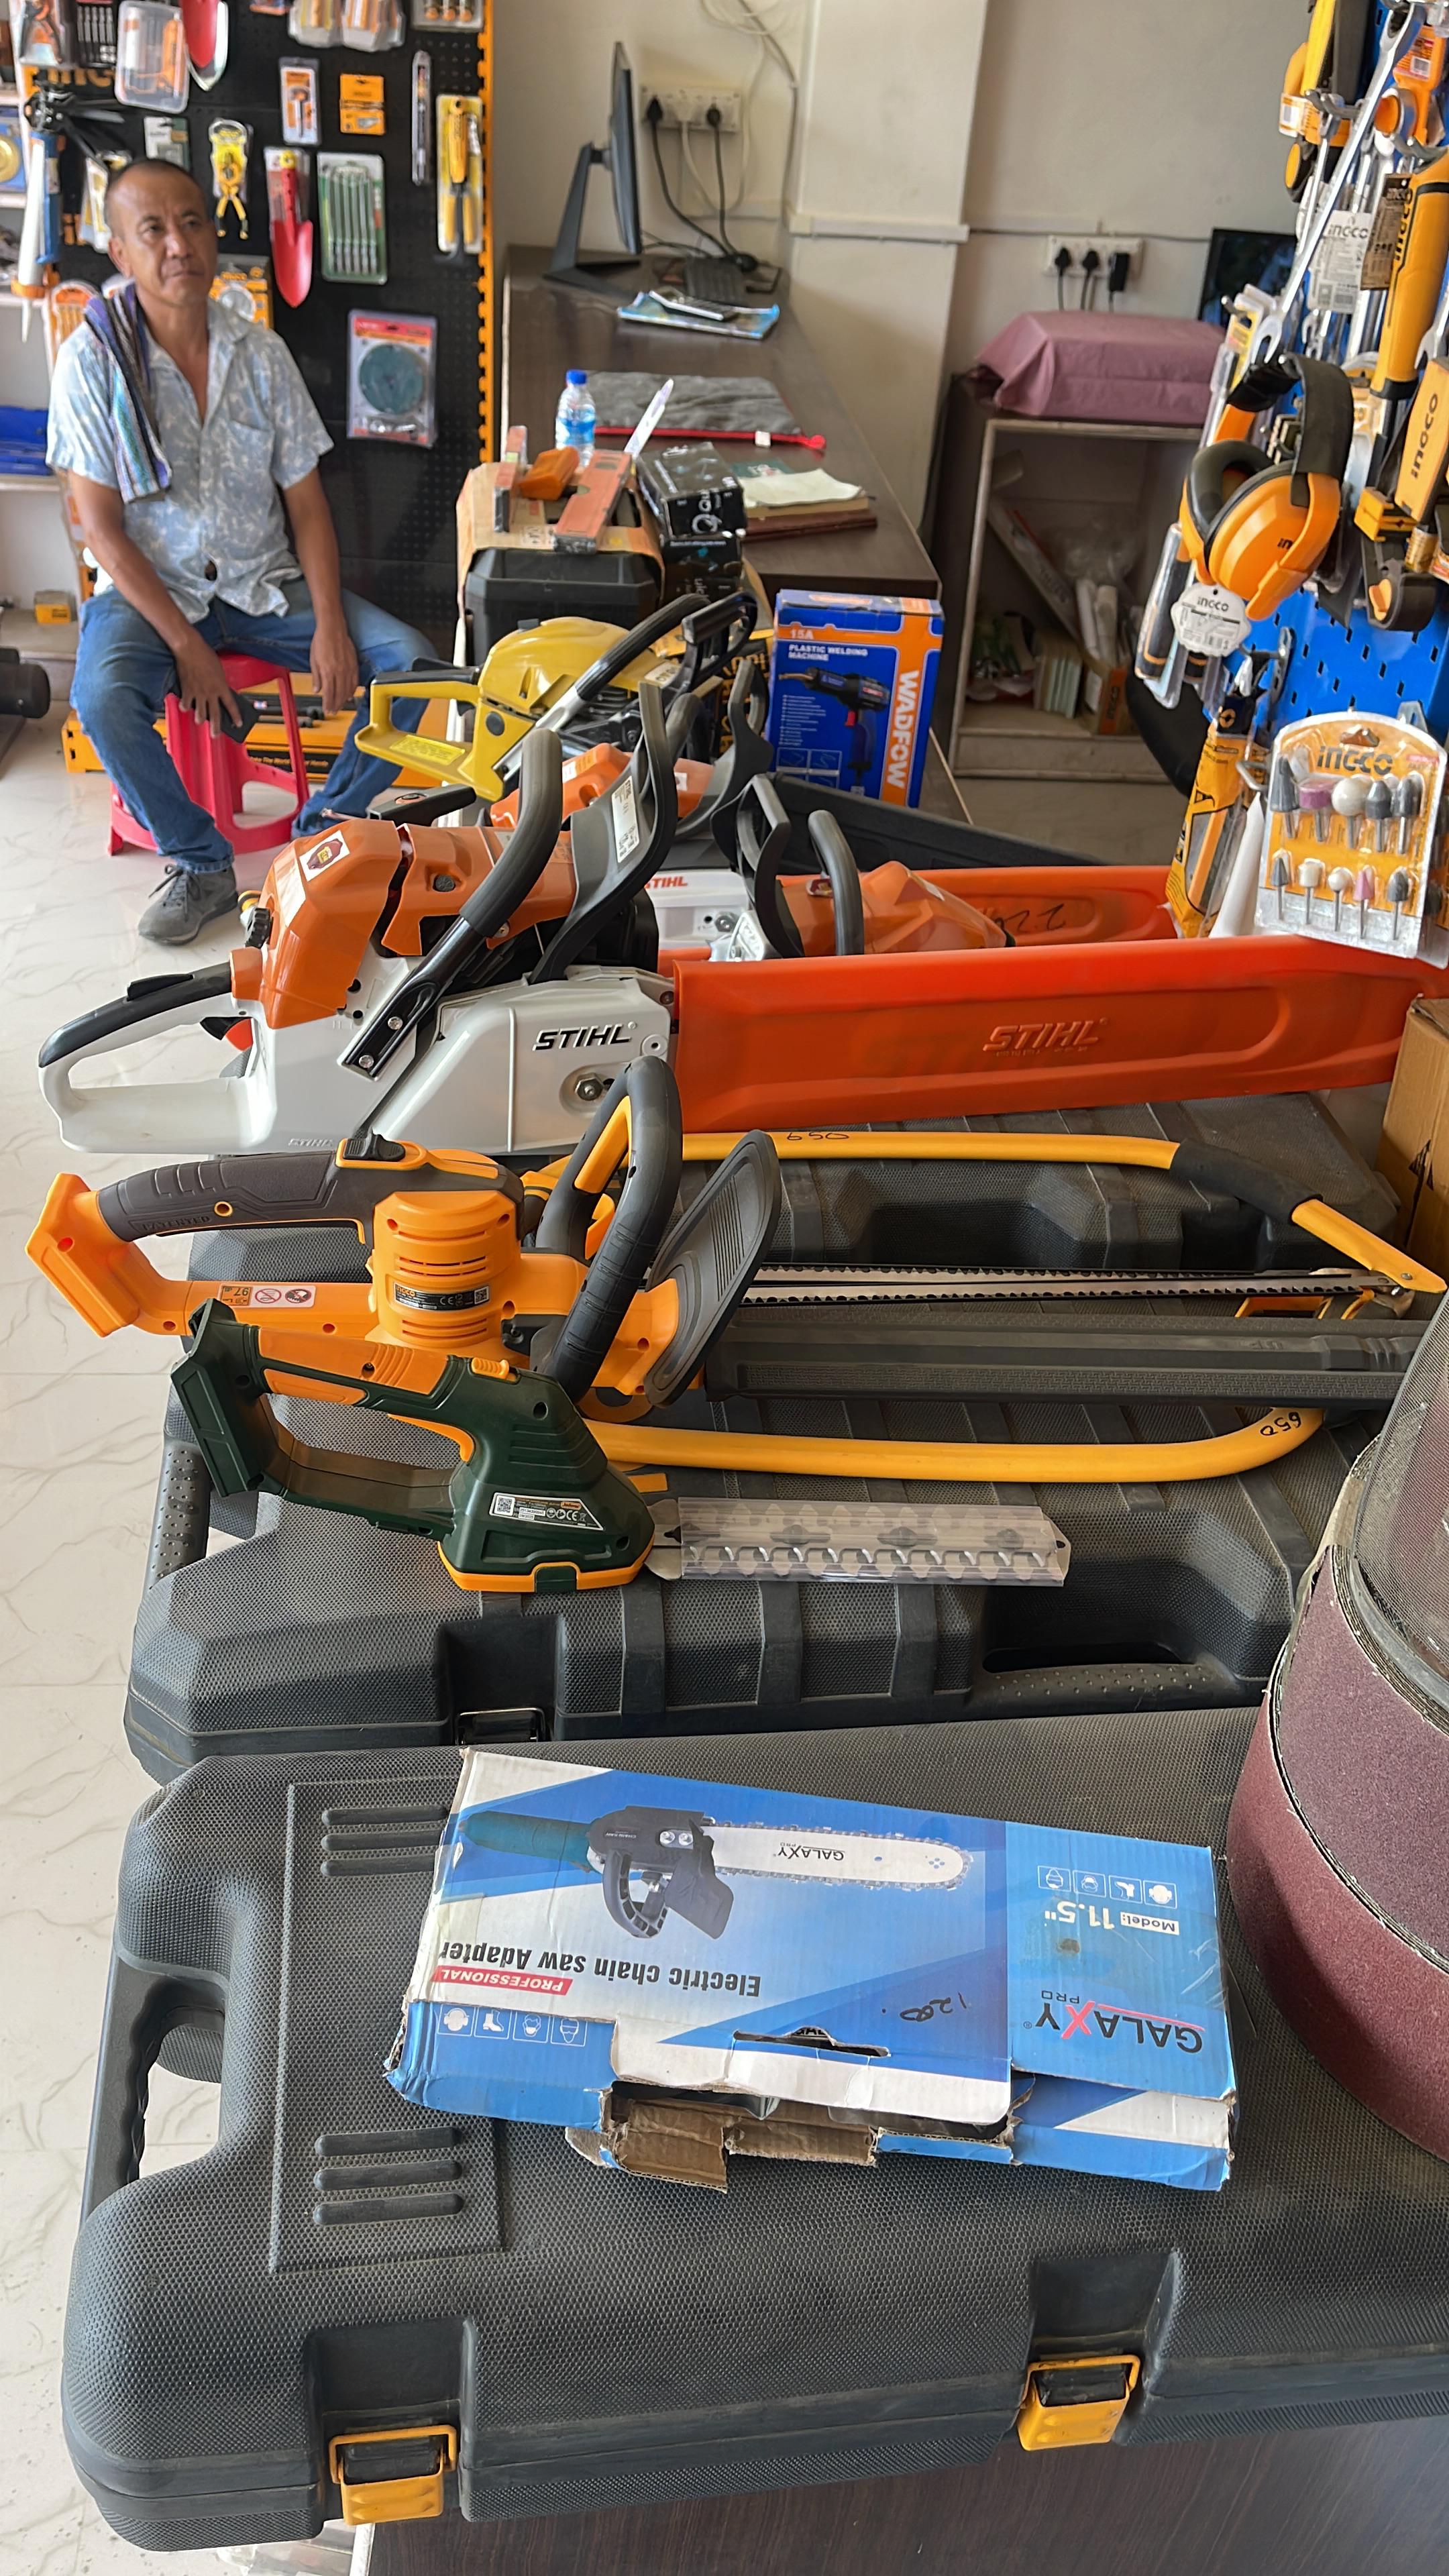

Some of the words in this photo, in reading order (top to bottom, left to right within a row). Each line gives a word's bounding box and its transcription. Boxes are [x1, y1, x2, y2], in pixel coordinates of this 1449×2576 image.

[790, 629, 814, 640] 15A
[788, 651, 829, 661] MACHINE
[789, 644, 826, 653] PLASTIC
[827, 647, 869, 657] WELDING
[887, 670, 920, 789] WADFOW
[533, 1024, 632, 1051] STIHL
[983, 1020, 1099, 1052] STIHL
[787, 1132, 849, 1140] 650
[142, 1216, 211, 1230] PATENTED
[233, 1287, 249, 1296] 97
[778, 1845, 844, 1860] GALAXY
[1044, 1900, 1115, 1930] 11.5"
[1122, 1914, 1175, 1932] Model:
[439, 1941, 531, 1970] Adapter
[537, 1951, 586, 1973] saw
[441, 1969, 564, 1992] PROFESSIONAL
[595, 1958, 660, 1984] chain
[669, 1969, 761, 1997] Electric
[1041, 1990, 1080, 2004] PRO
[1035, 2000, 1203, 2053] GALAXY
